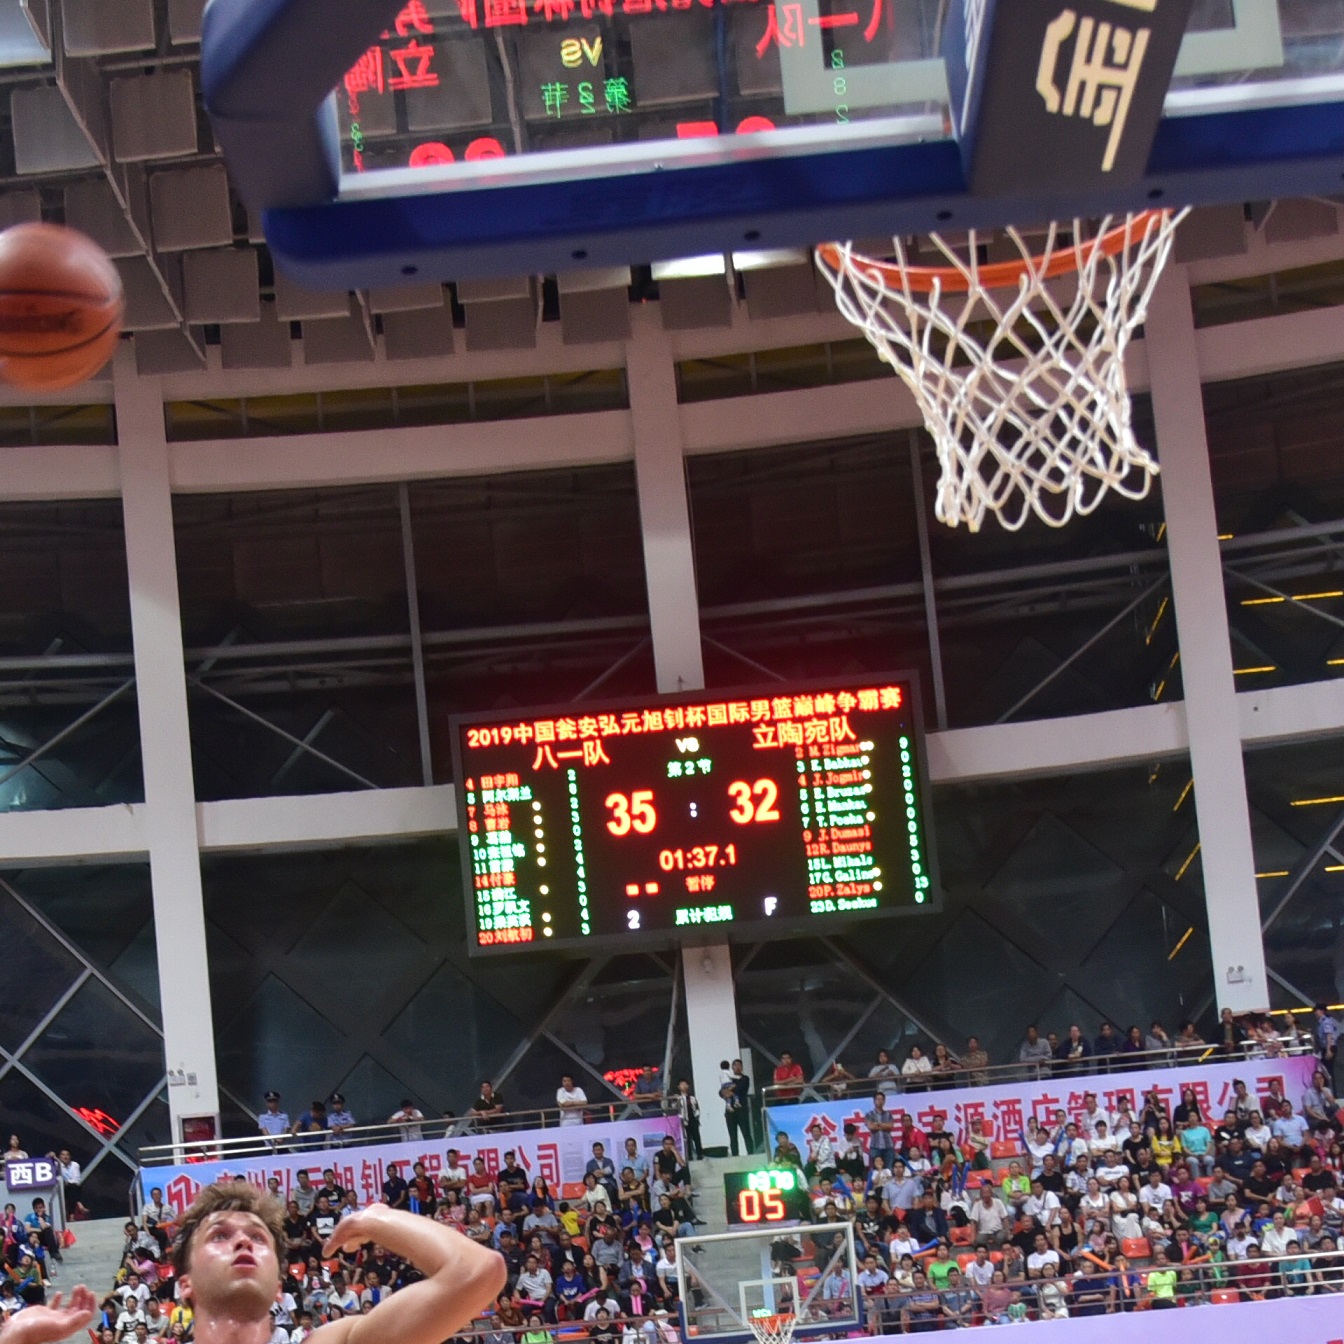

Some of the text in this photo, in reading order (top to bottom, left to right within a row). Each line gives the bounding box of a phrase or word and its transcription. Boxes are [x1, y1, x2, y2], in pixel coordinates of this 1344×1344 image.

[753, 715, 856, 749] 立陶宛队
[532, 739, 610, 770] 八一队
[466, 778, 474, 791] 4
[467, 792, 476, 804] 5
[727, 778, 780, 824] 32
[468, 806, 476, 818] 7
[605, 790, 657, 836] 35
[469, 820, 478, 832] 8
[470, 834, 478, 846] 9
[473, 848, 486, 860] 10
[659, 844, 736, 871] 01:37.1
[475, 862, 487, 874] 11
[476, 875, 489, 888] 14
[477, 890, 489, 902] 15
[478, 904, 491, 916] 16
[479, 918, 492, 930] 19
[627, 909, 640, 929] 2
[479, 932, 493, 944] 20
[7, 1162, 54, 1186] 西B
[738, 1188, 785, 1221] 05
